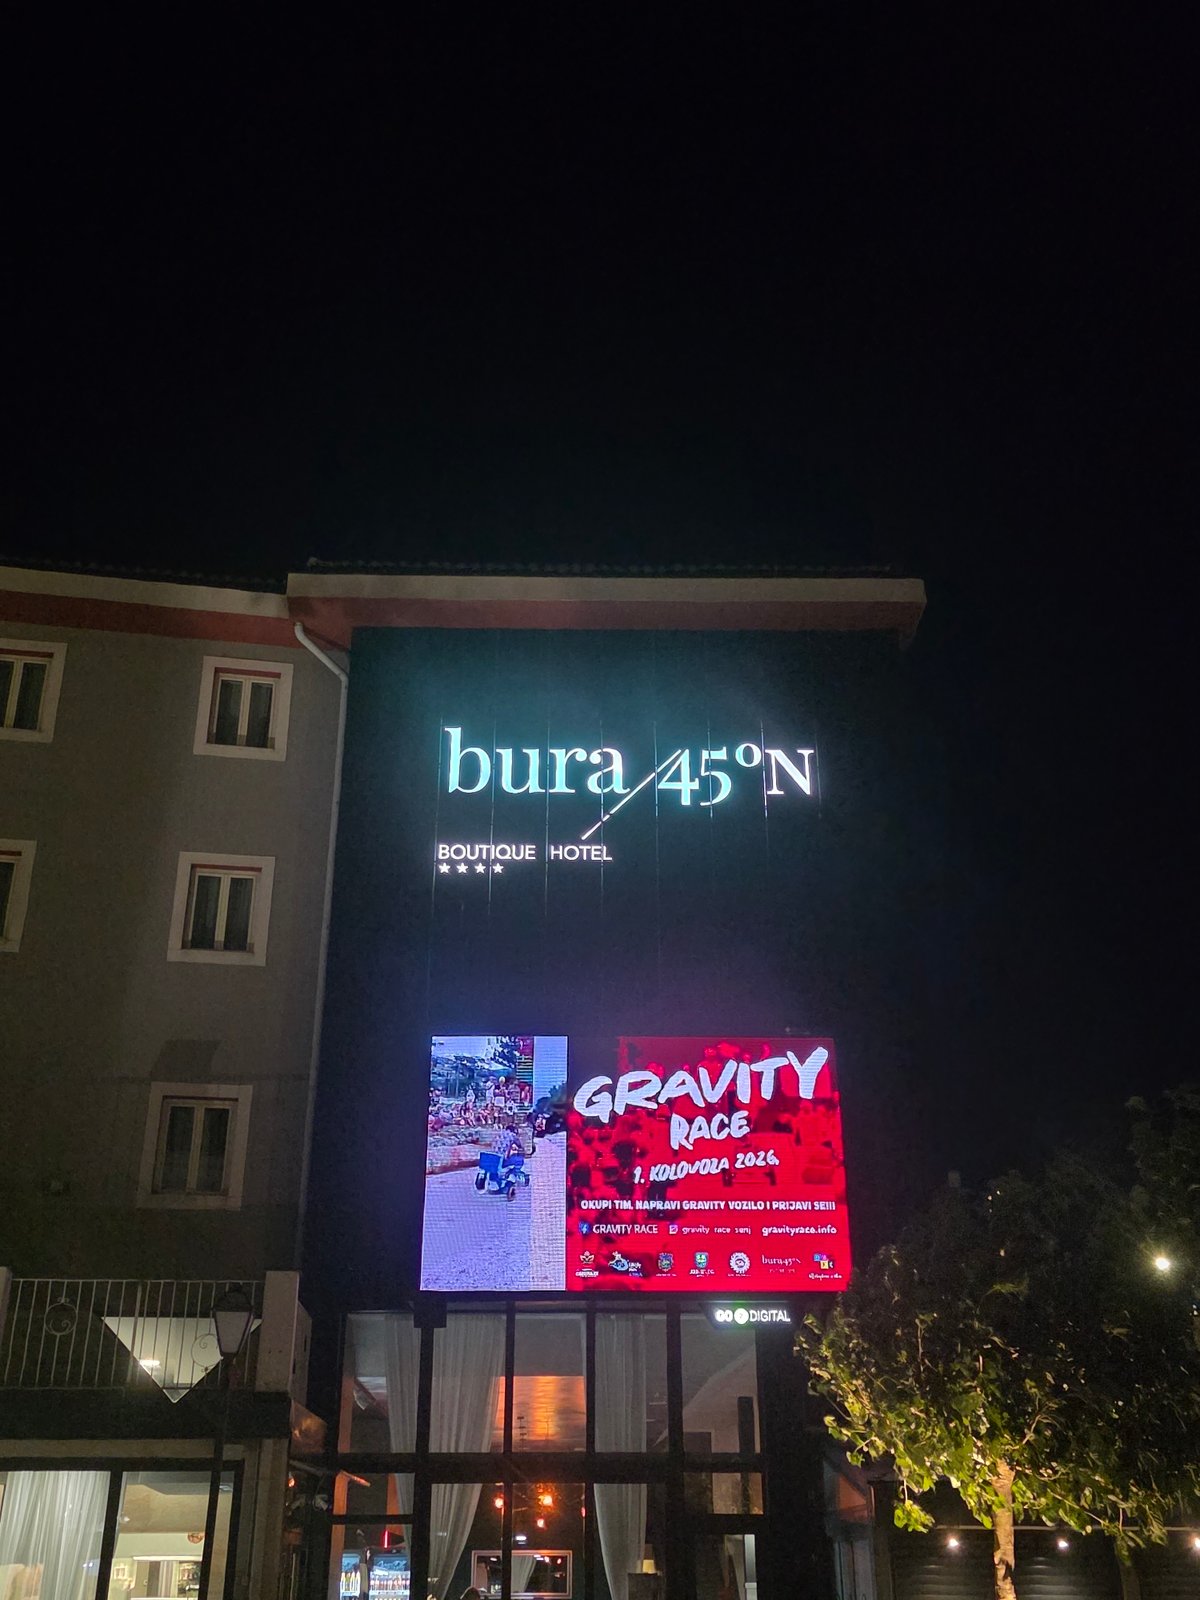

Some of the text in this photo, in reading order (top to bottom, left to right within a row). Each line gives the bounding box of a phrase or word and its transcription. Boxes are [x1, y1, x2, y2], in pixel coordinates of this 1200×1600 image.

[444, 727, 631, 794] bura
[438, 844, 613, 861] BOUTIQUE HOTEL
[573, 1047, 829, 1124] GRAVITY
[670, 1110, 751, 1151] RACE
[633, 1166, 645, 1184] 1.
[649, 1157, 730, 1182] KOLOVOZA
[580, 1200, 612, 1210] OKUPI
[635, 1200, 681, 1210] NAPRAVI
[682, 1200, 726, 1211] GRAVITY
[728, 1201, 765, 1211] VOZILO
[767, 1201, 770, 1211] I
[772, 1201, 812, 1211] PRIJAVI
[592, 1224, 659, 1234] GRAVITY RACE
[761, 1225, 837, 1237] gravityrace.info
[749, 1310, 791, 1322] DIGITAL
